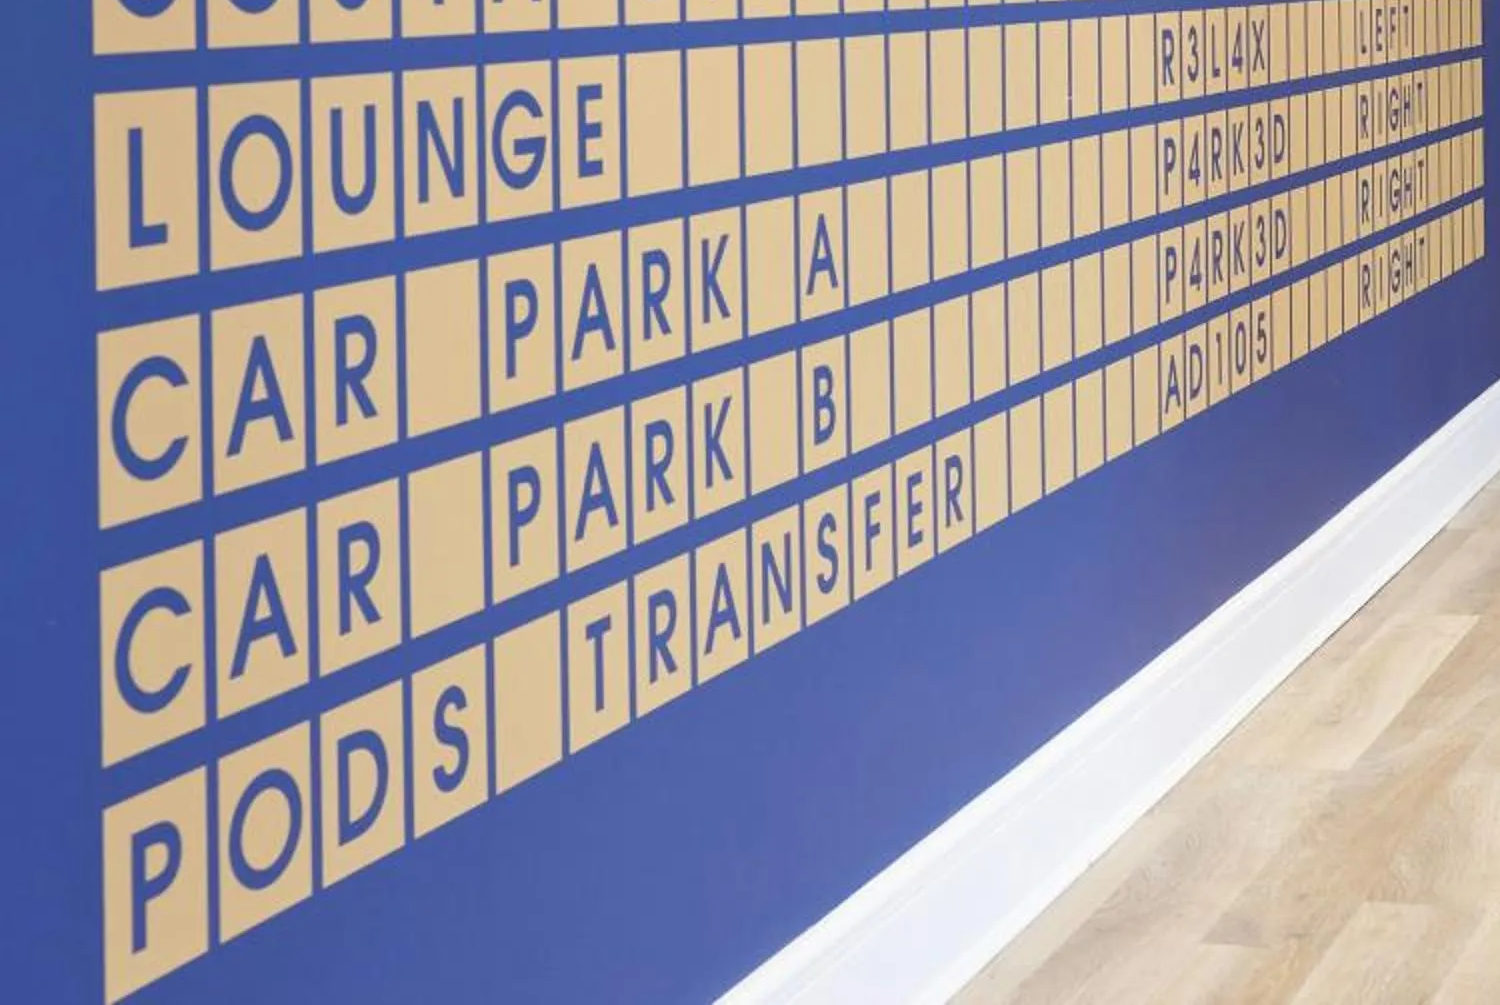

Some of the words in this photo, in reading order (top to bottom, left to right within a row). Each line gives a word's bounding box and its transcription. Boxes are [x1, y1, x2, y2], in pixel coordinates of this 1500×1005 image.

[109, 312, 380, 483] CAR
[503, 234, 731, 381] PARK
[806, 214, 839, 296] A
[1163, 113, 1286, 195] P4RK3D
[1360, 82, 1423, 139] RIGHT
[126, 82, 605, 250] LOUNGE
[1161, 19, 1266, 87] R3L4X
[1359, 5, 1409, 55] LEFT
[113, 519, 382, 717] CAR
[507, 397, 734, 568] PARK
[811, 363, 837, 447] B
[1165, 208, 1287, 304] P4RK3D
[1361, 159, 1424, 225] RIGHT
[129, 682, 471, 955] PODS
[584, 452, 966, 713] TRANSFER
[1362, 236, 1425, 310] RIGHT
